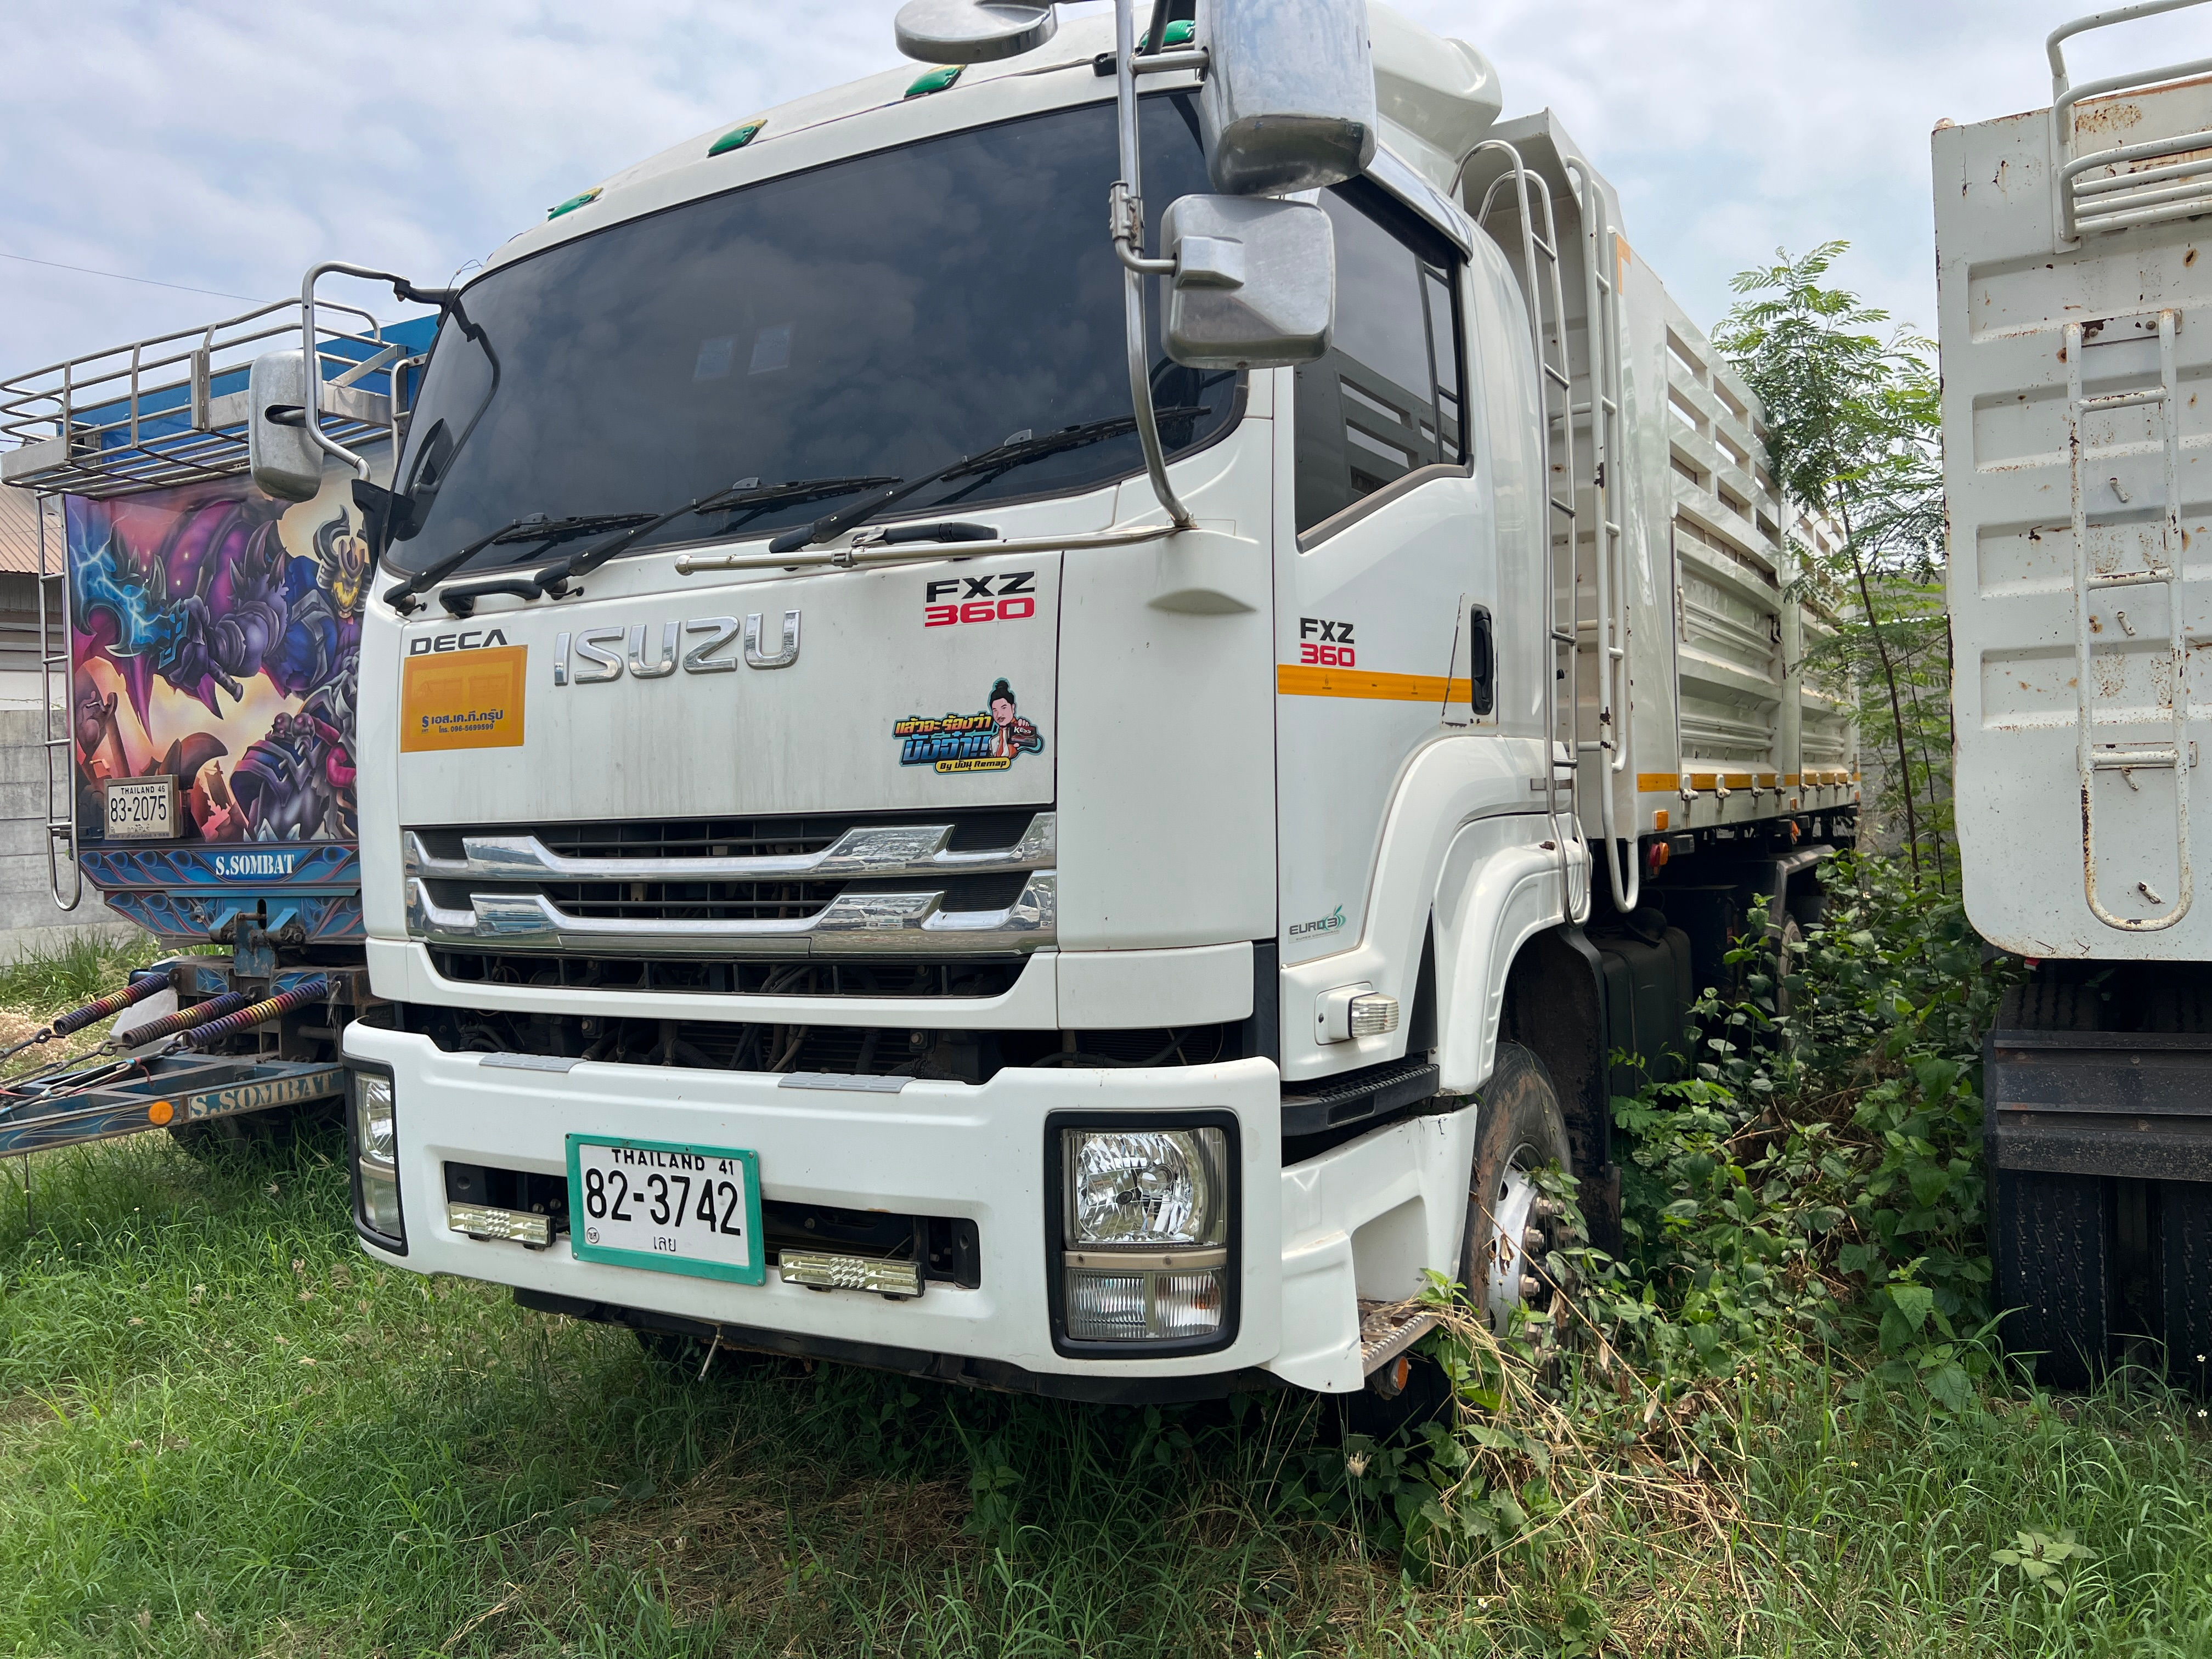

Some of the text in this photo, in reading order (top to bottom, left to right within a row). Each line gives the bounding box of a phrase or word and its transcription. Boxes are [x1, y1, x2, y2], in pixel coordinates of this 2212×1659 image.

[927, 571, 1035, 602] FXZ
[925, 597, 1035, 627] 360
[410, 629, 507, 656] DECA
[1300, 617, 1355, 644] FXZ
[555, 610, 802, 686] ISUZU
[1300, 643, 1355, 667] 360
[940, 763, 952, 771] By
[121, 786, 154, 794] THAILAND
[110, 795, 166, 822] 83-2075
[216, 854, 294, 876] S.SOMBAT
[190, 1073, 335, 1118] S.SOMBAT
[612, 1149, 734, 1175] THAILAND 41
[585, 1167, 741, 1236] 82-3742
[653, 1236, 676, 1251] เลย
